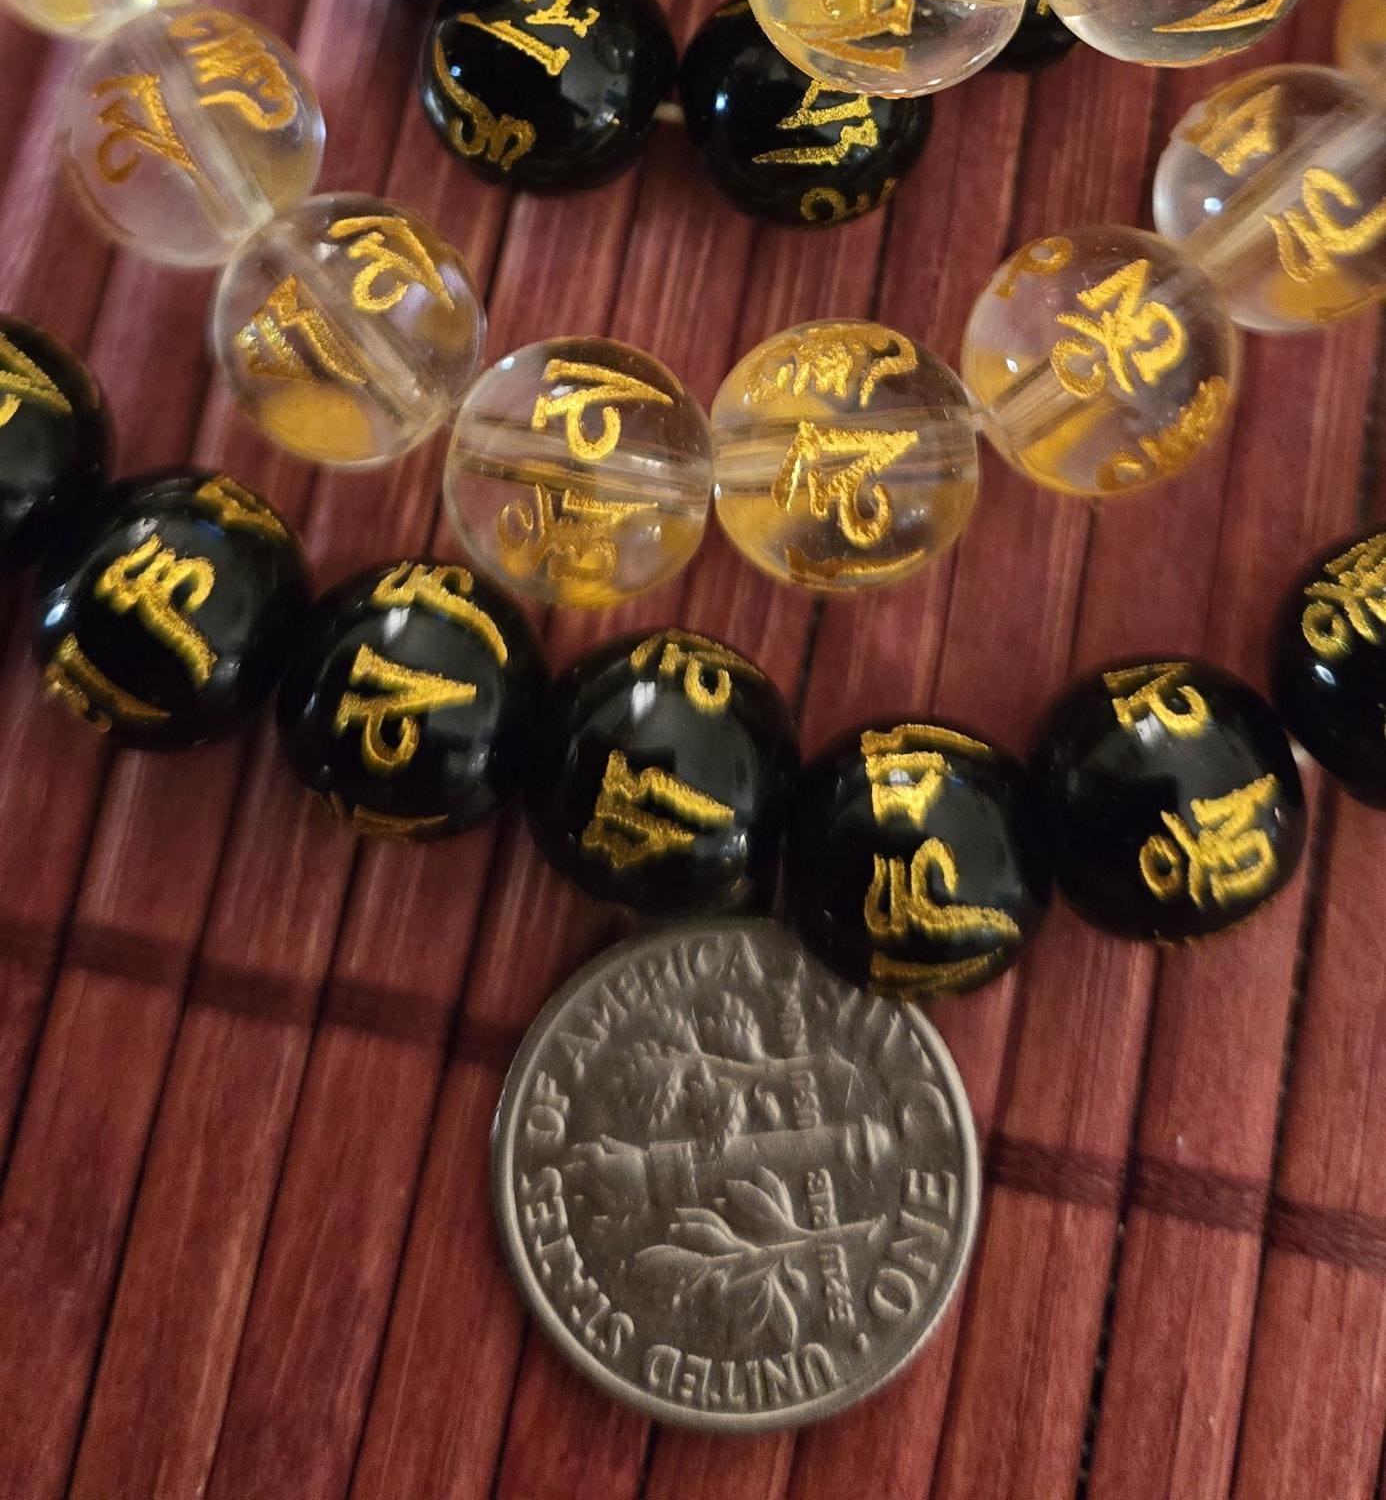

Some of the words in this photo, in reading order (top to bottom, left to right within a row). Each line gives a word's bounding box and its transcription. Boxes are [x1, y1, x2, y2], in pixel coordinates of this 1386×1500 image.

[557, 930, 768, 1085] AMERICA
[525, 1069, 571, 1147] OF
[519, 1166, 635, 1359] STATES
[868, 1168, 957, 1323] ONE
[645, 1343, 838, 1410] UNITED
